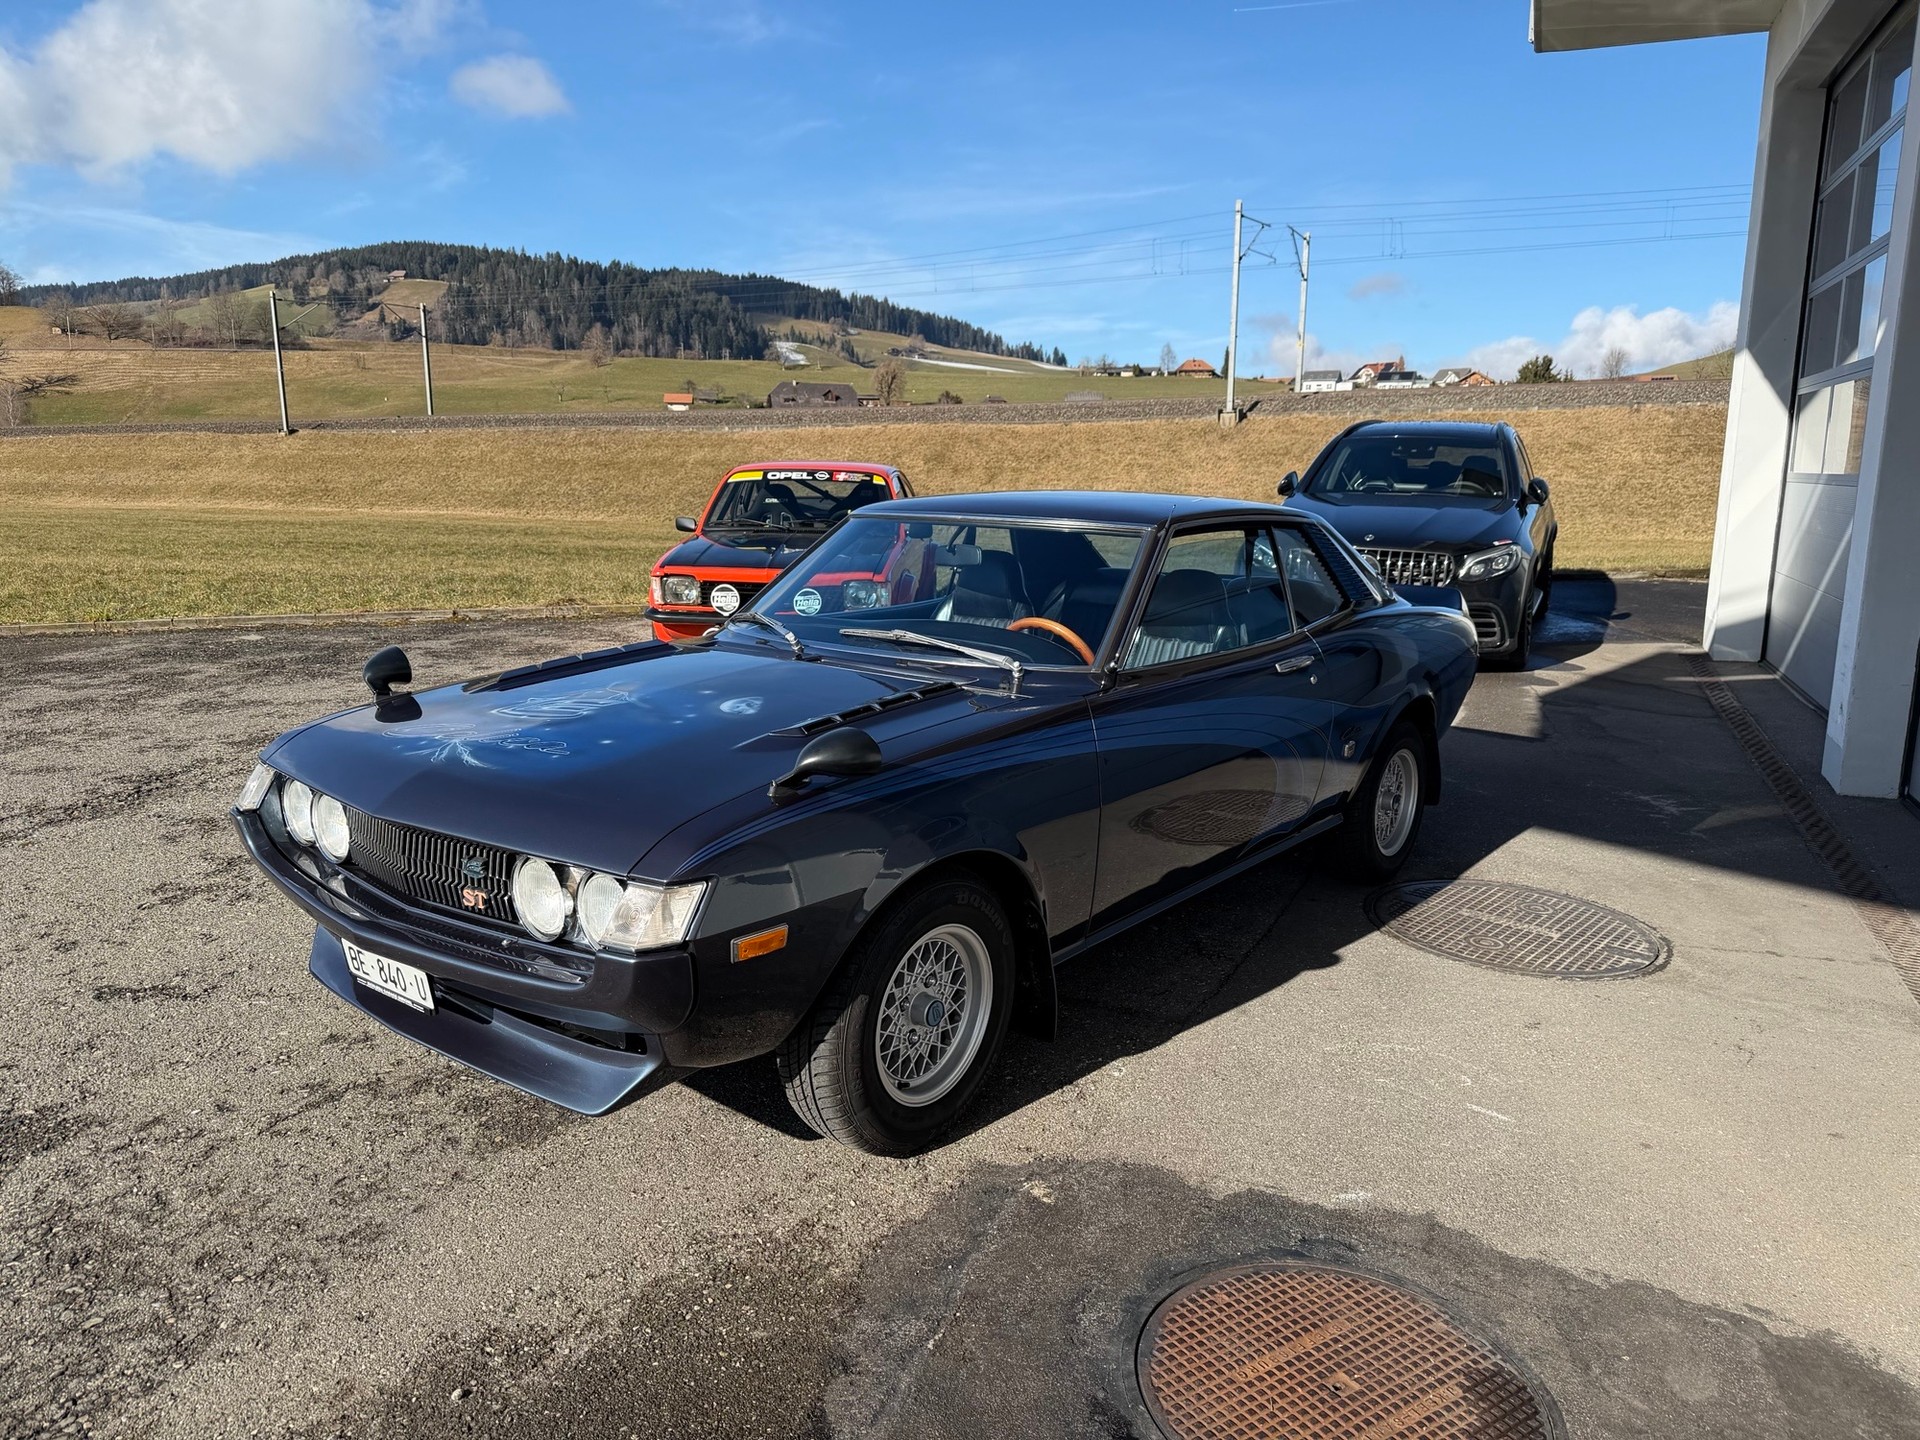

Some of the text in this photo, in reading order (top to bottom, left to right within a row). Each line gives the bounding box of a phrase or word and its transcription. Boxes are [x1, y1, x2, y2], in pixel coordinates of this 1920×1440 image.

[767, 471, 813, 480] OPEL
[796, 598, 820, 607] Hella
[463, 886, 488, 909] ST
